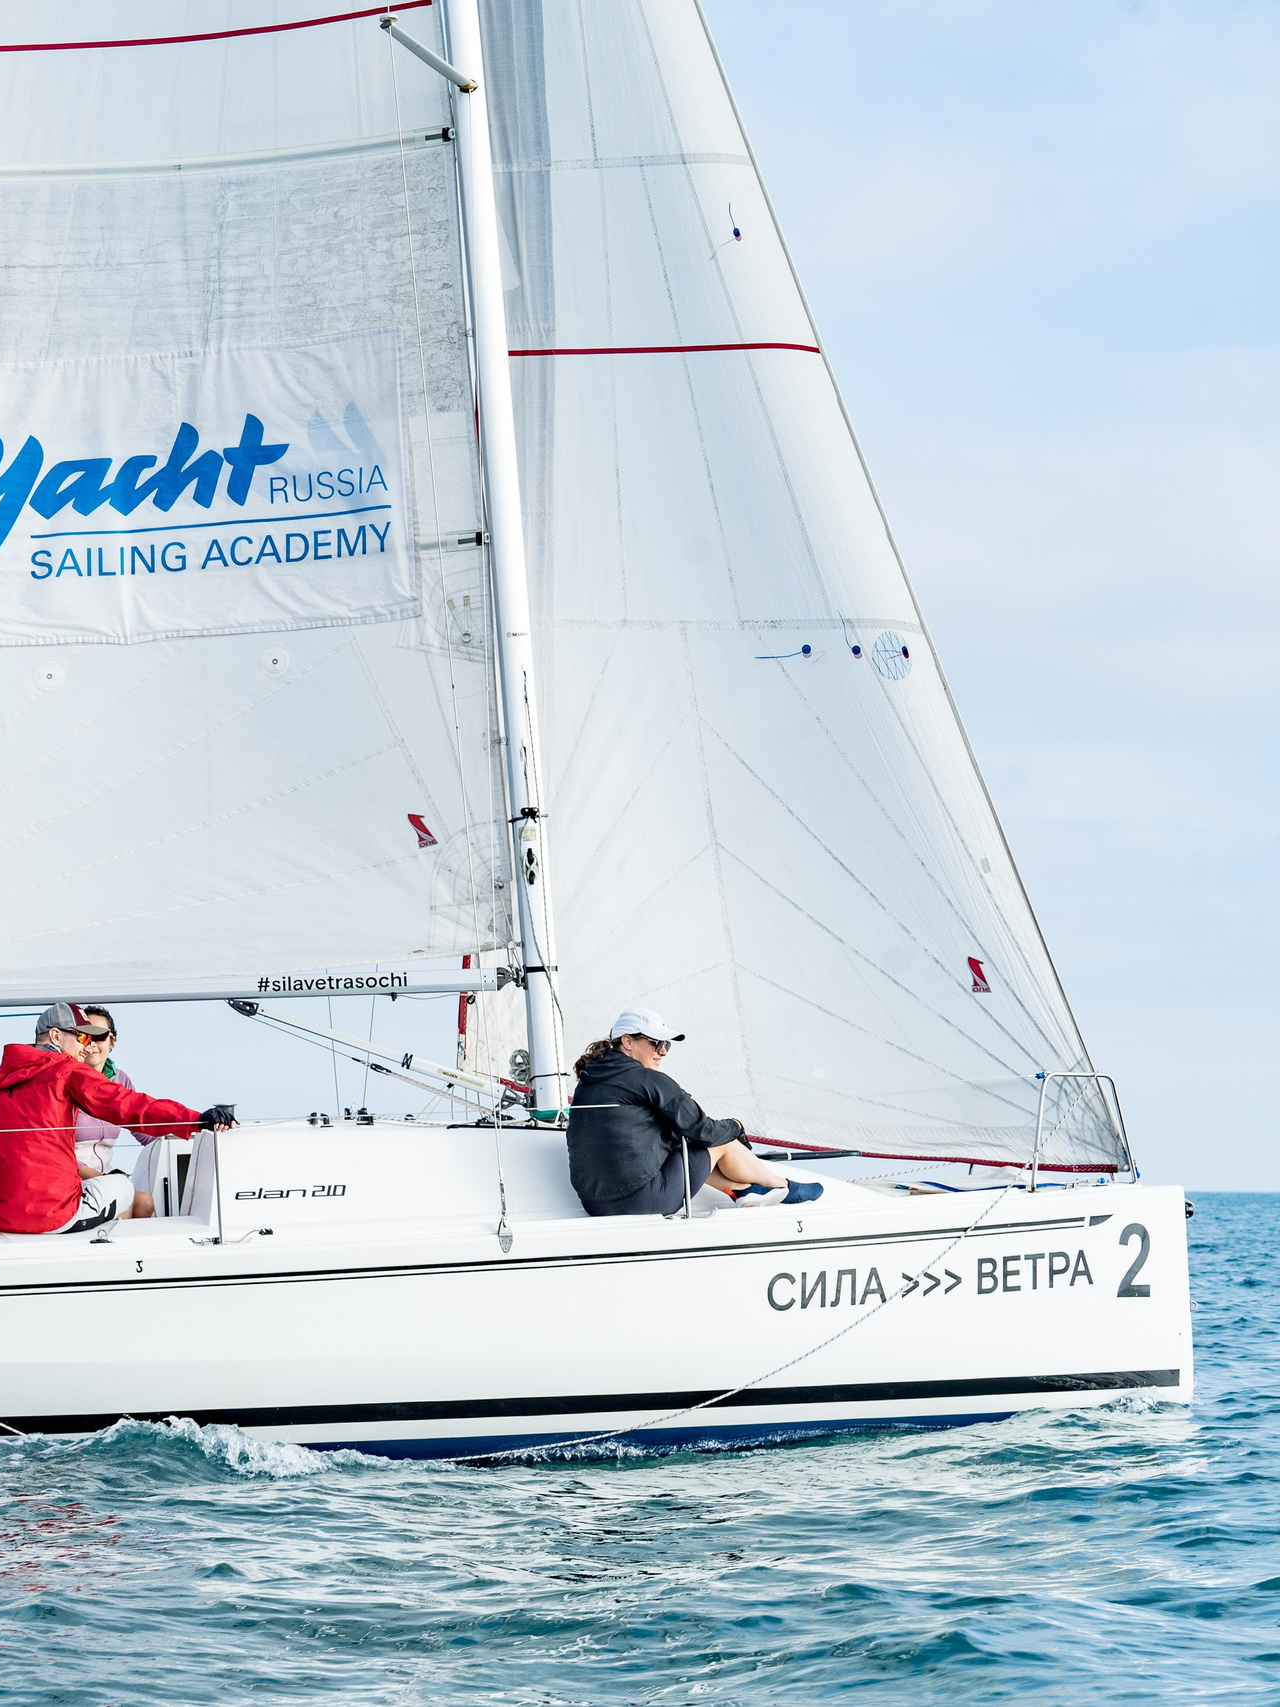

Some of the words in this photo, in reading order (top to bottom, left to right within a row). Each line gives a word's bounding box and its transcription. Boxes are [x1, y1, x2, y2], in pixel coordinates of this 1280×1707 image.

[269, 464, 388, 505] RUSSIA
[31, 542, 188, 580] SAILING
[201, 521, 392, 570] ACADEMY
[257, 972, 408, 992] #silavetrasochi
[235, 1187, 307, 1200] elan
[311, 1184, 346, 1197] 210
[767, 1267, 887, 1312] СИЛА
[977, 1249, 1094, 1295] ВЕТРА
[1116, 1222, 1151, 1298] 2
